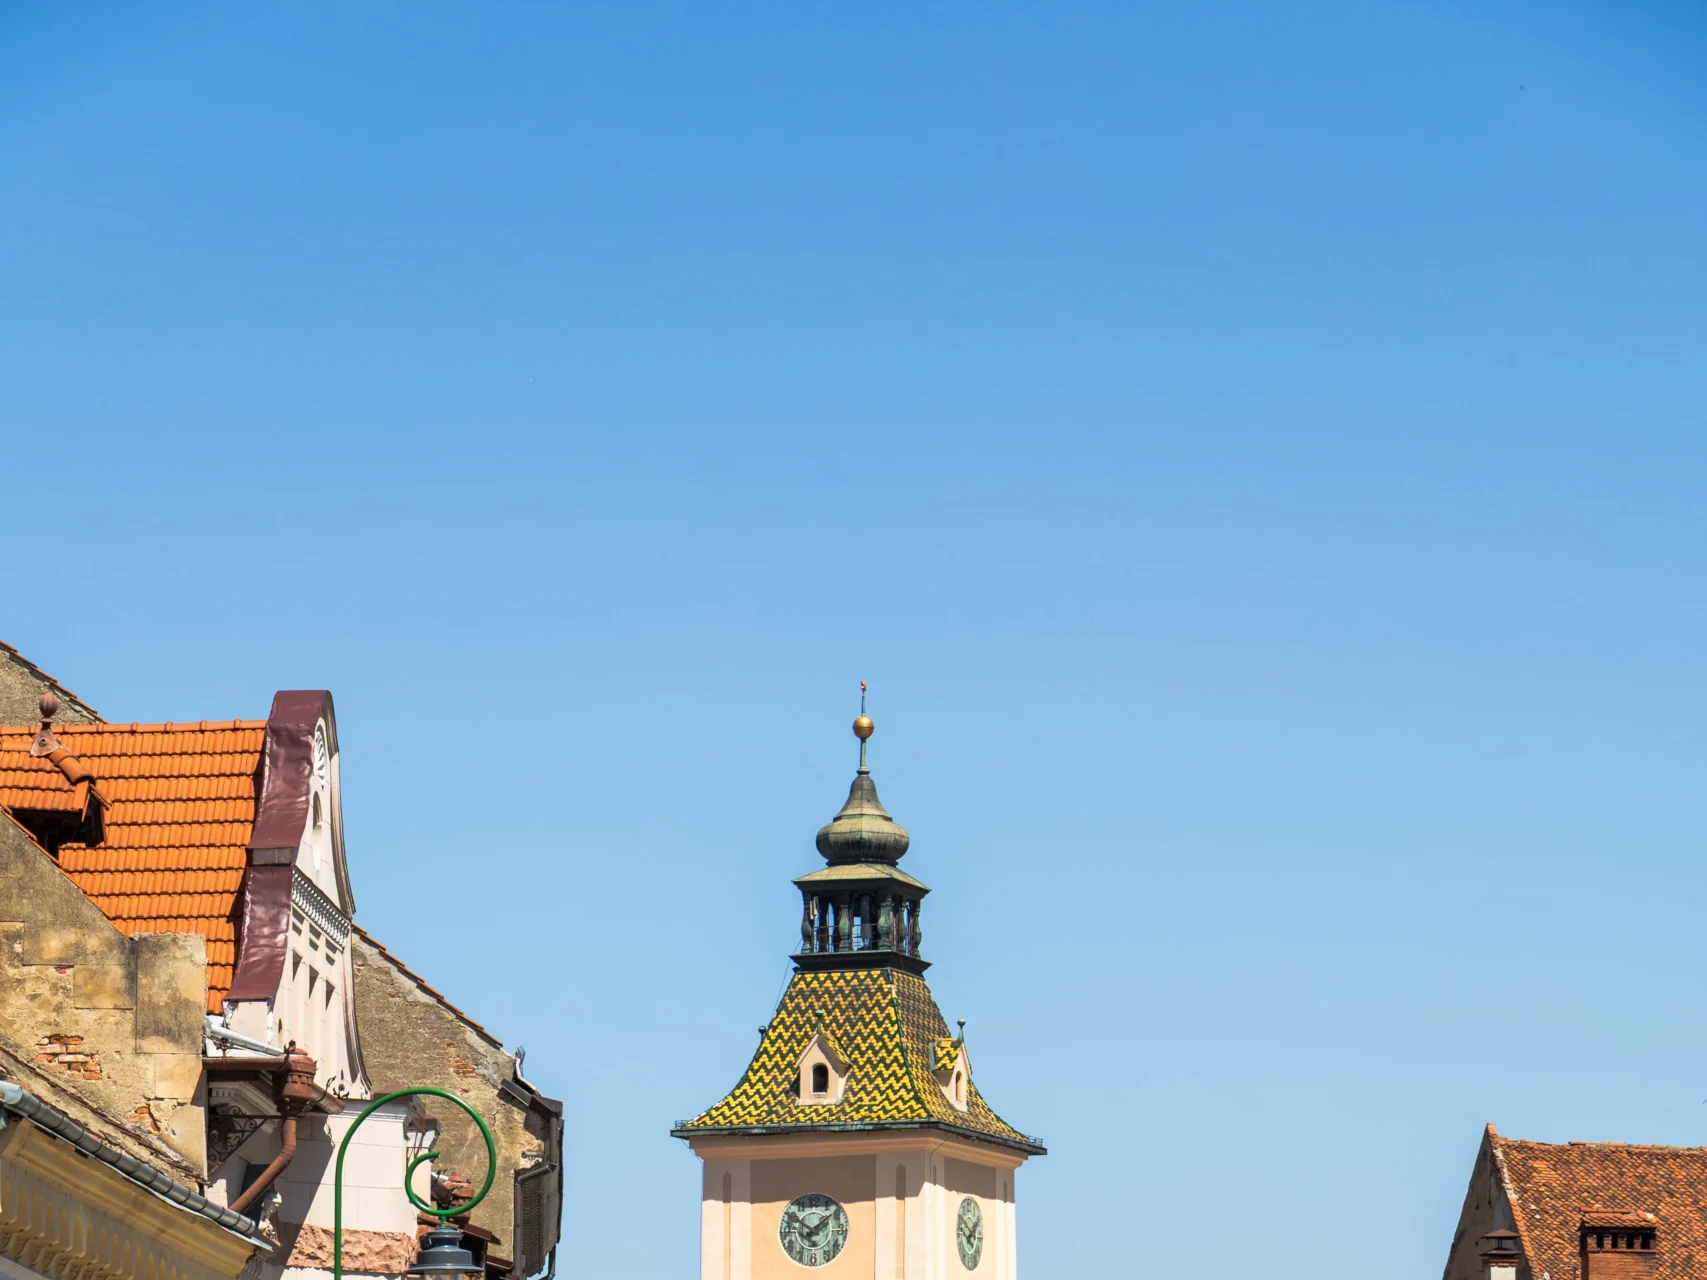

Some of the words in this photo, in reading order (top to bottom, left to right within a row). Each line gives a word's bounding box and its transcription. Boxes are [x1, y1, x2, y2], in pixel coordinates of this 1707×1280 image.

[797, 1201, 805, 1212] 11
[808, 1194, 820, 1208] 12
[824, 1200, 830, 1211] 1
[837, 1224, 845, 1235] 3
[810, 1252, 818, 1265] 6
[823, 1250, 829, 1261] 5
